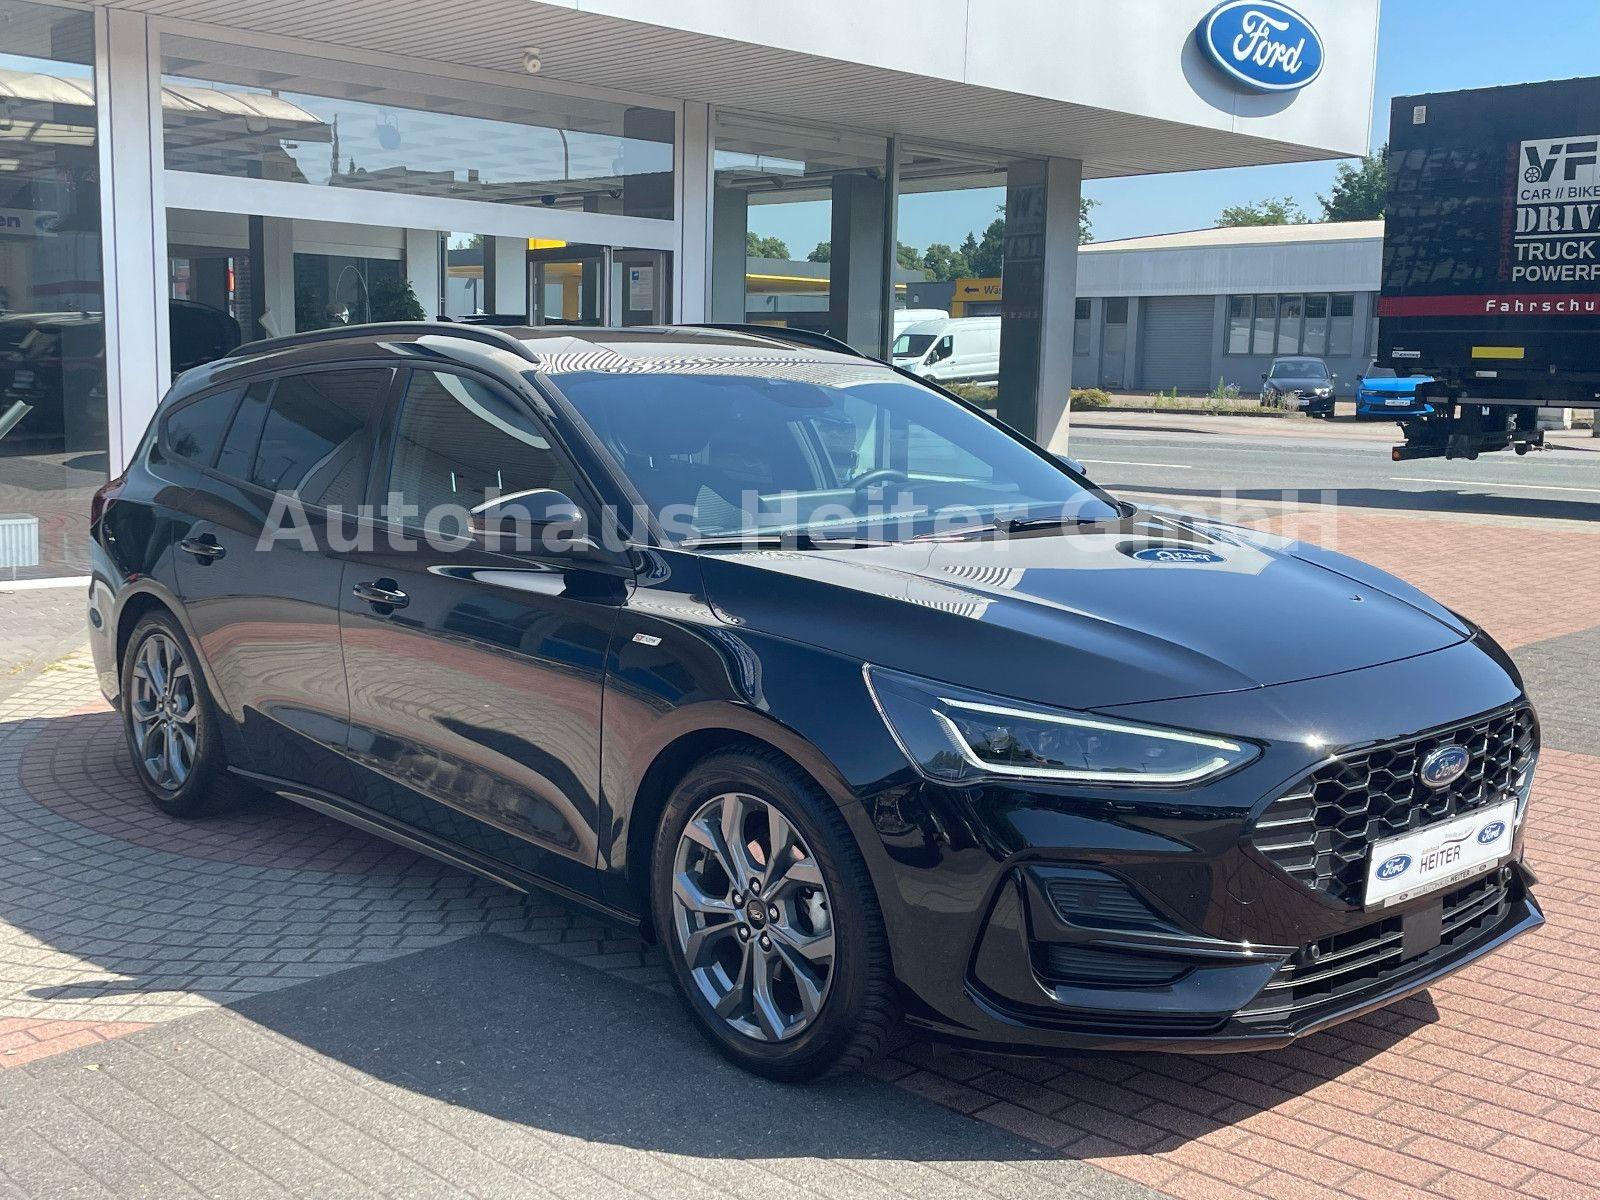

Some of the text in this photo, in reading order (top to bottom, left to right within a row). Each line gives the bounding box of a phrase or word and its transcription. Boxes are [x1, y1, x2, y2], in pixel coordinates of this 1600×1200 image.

[1233, 10, 1306, 74] Ford
[1521, 188, 1551, 200] CAR
[1515, 204, 1600, 232] DRIV
[1514, 240, 1595, 260] TRUCK
[984, 285, 1001, 295] Wa
[1486, 298, 1595, 312] Fahrschu
[1435, 755, 1462, 779] Ford
[1420, 845, 1461, 874] HEITER
